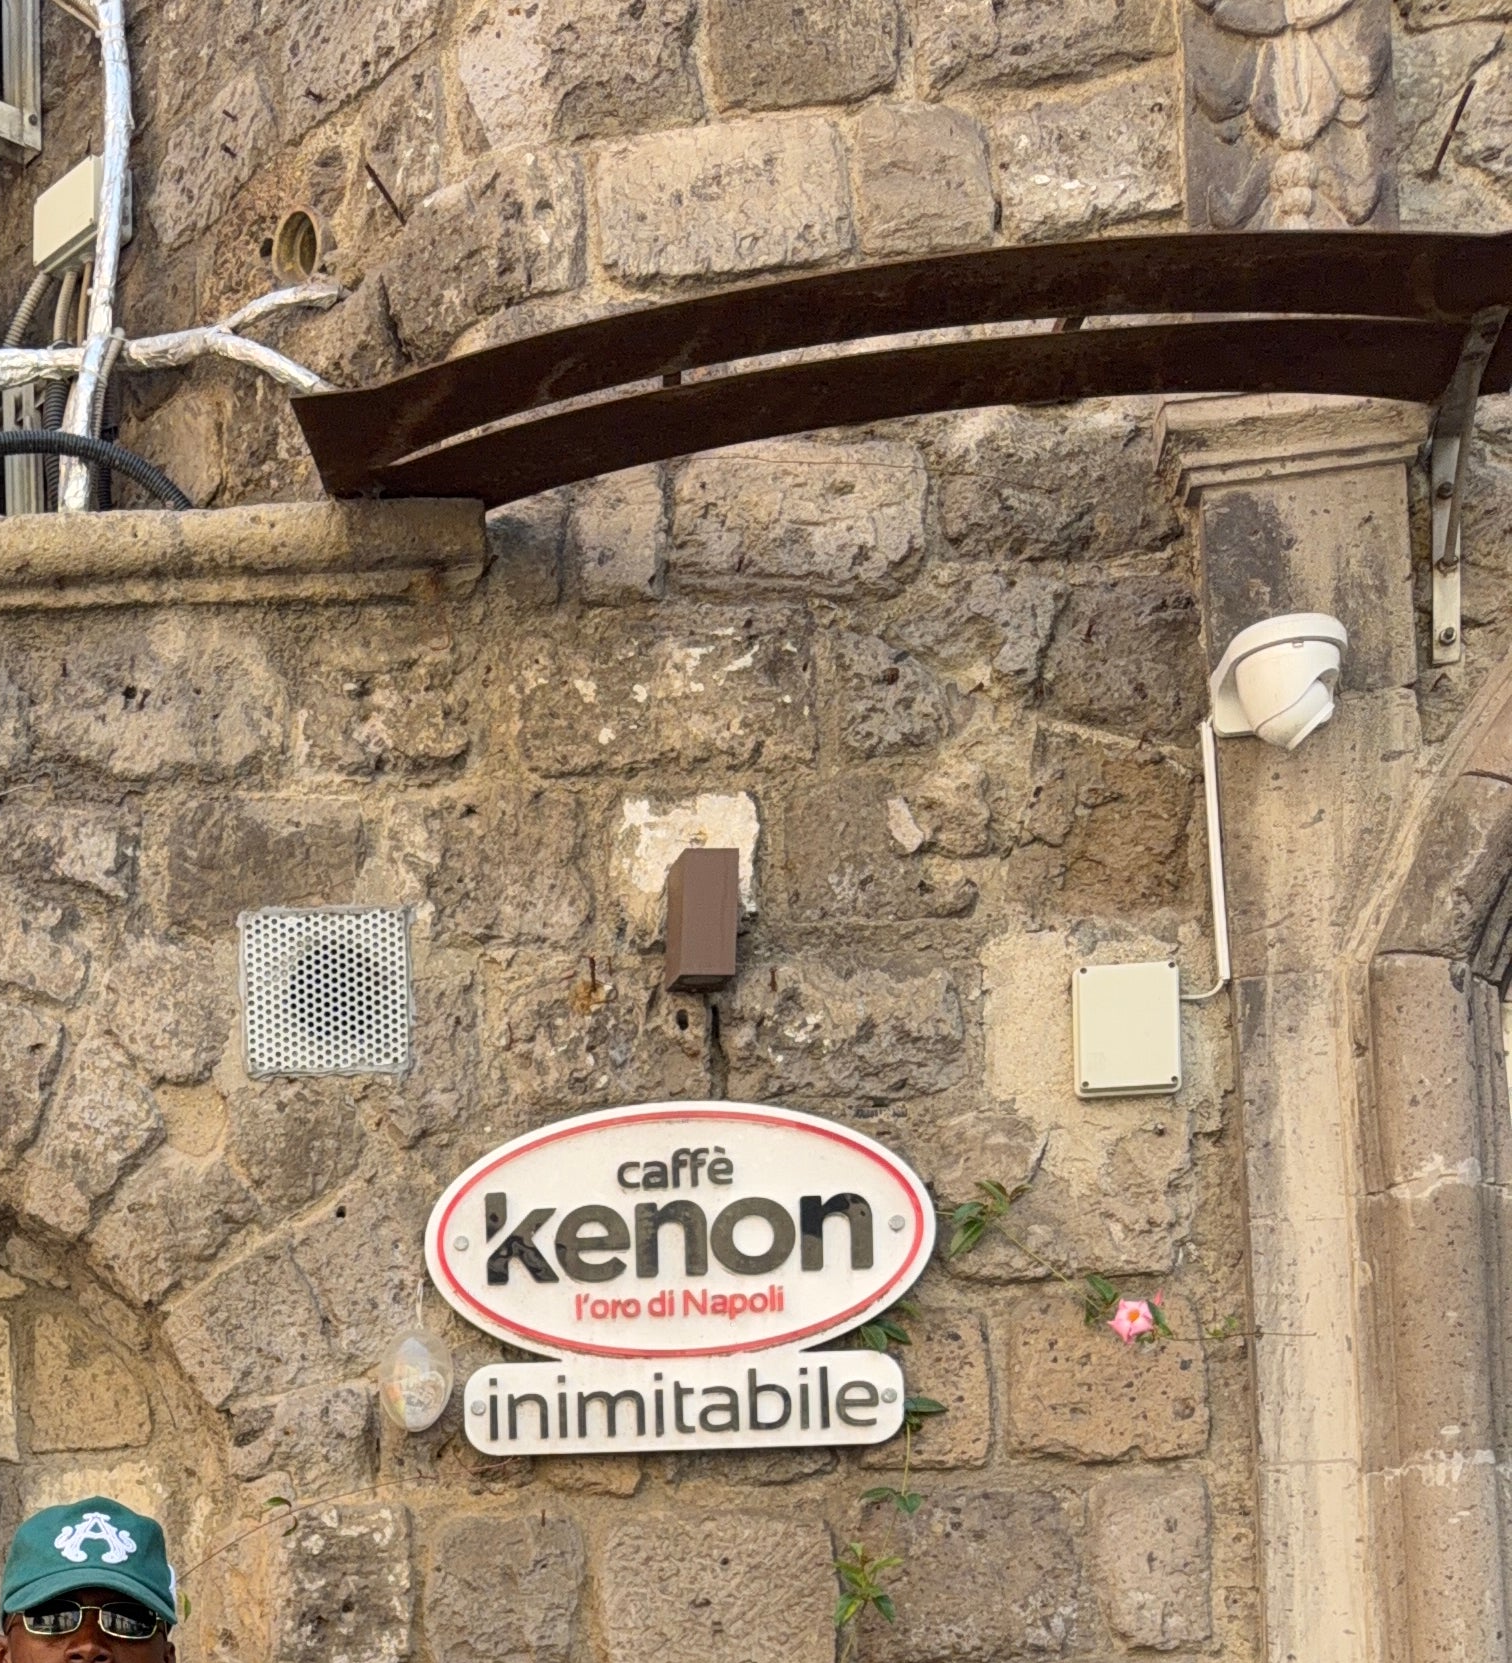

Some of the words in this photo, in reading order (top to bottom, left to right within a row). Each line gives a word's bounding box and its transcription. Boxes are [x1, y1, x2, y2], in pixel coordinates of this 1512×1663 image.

[617, 1146, 735, 1191] caffè
[484, 1191, 875, 1287] kenon
[575, 1292, 642, 1321] l'oro
[647, 1288, 676, 1318] di
[682, 1284, 785, 1321] Napoli
[488, 1365, 881, 1442] inimitabile
